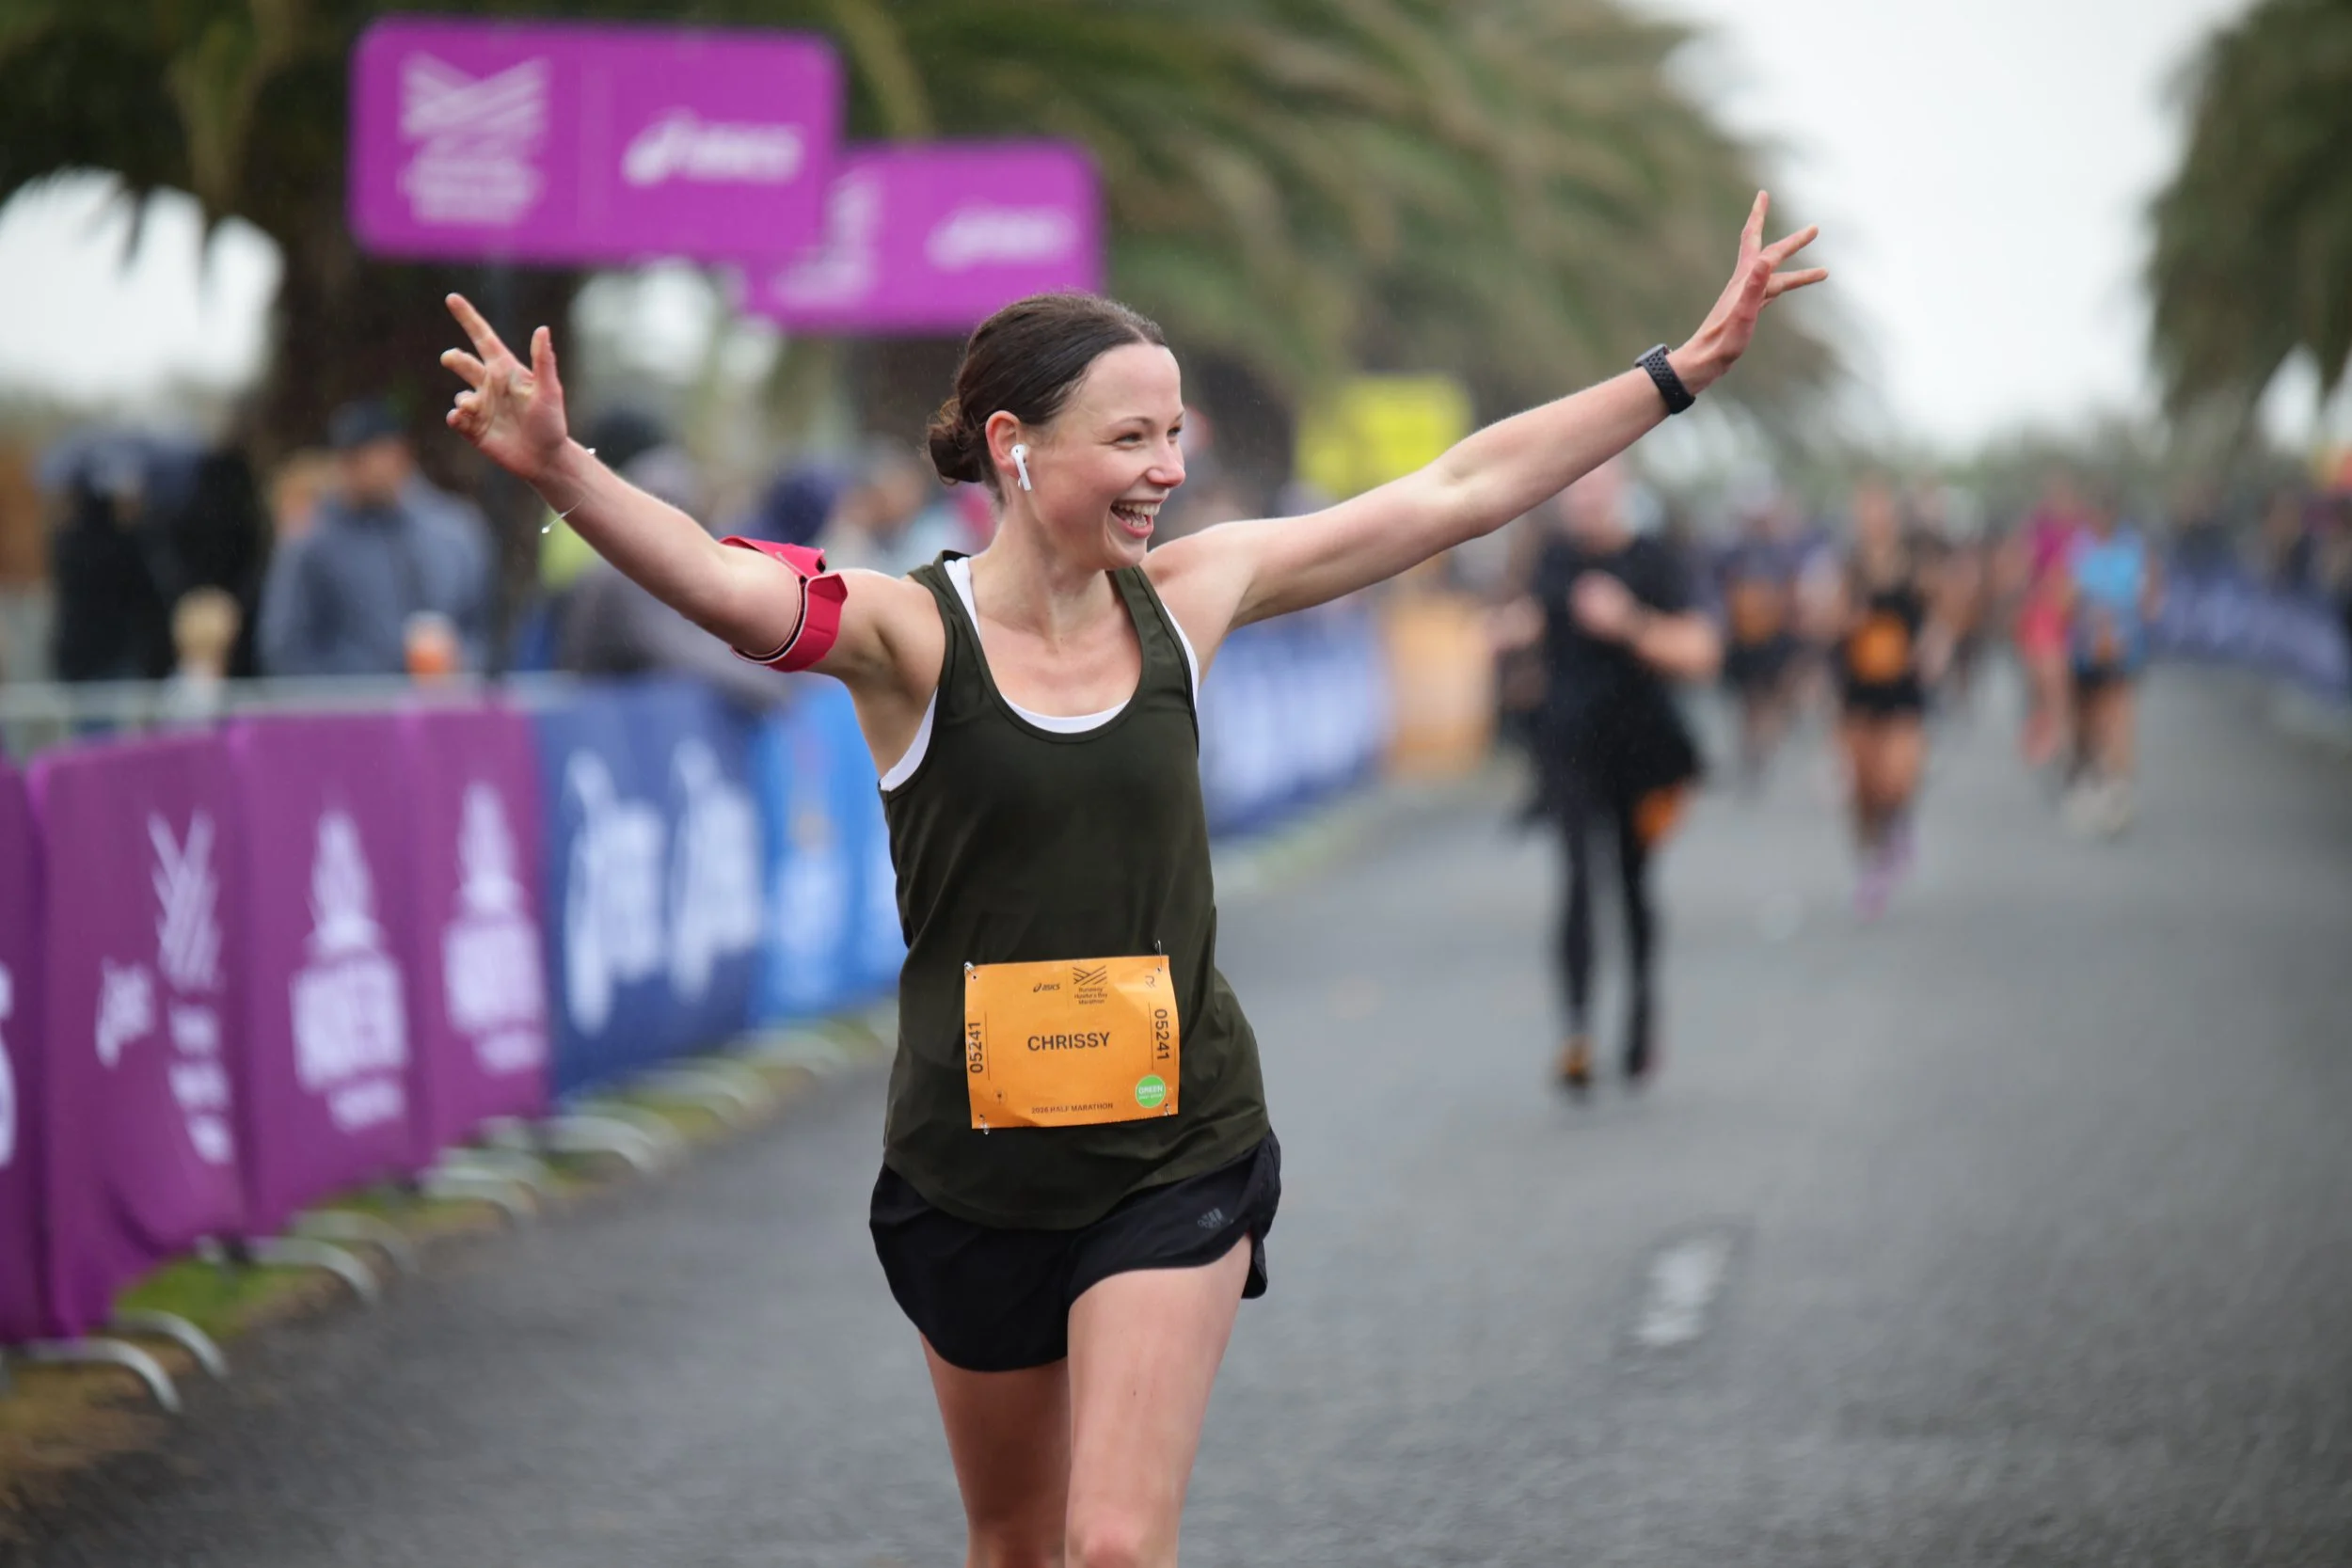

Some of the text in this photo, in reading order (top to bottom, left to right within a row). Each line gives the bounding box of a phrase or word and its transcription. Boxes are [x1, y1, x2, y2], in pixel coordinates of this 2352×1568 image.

[968, 1022, 983, 1073] 05241
[1027, 1032, 1110, 1052] CHRISSY
[1154, 1008, 1169, 1060] 05241
[1071, 1102, 1113, 1111] MARATHON
